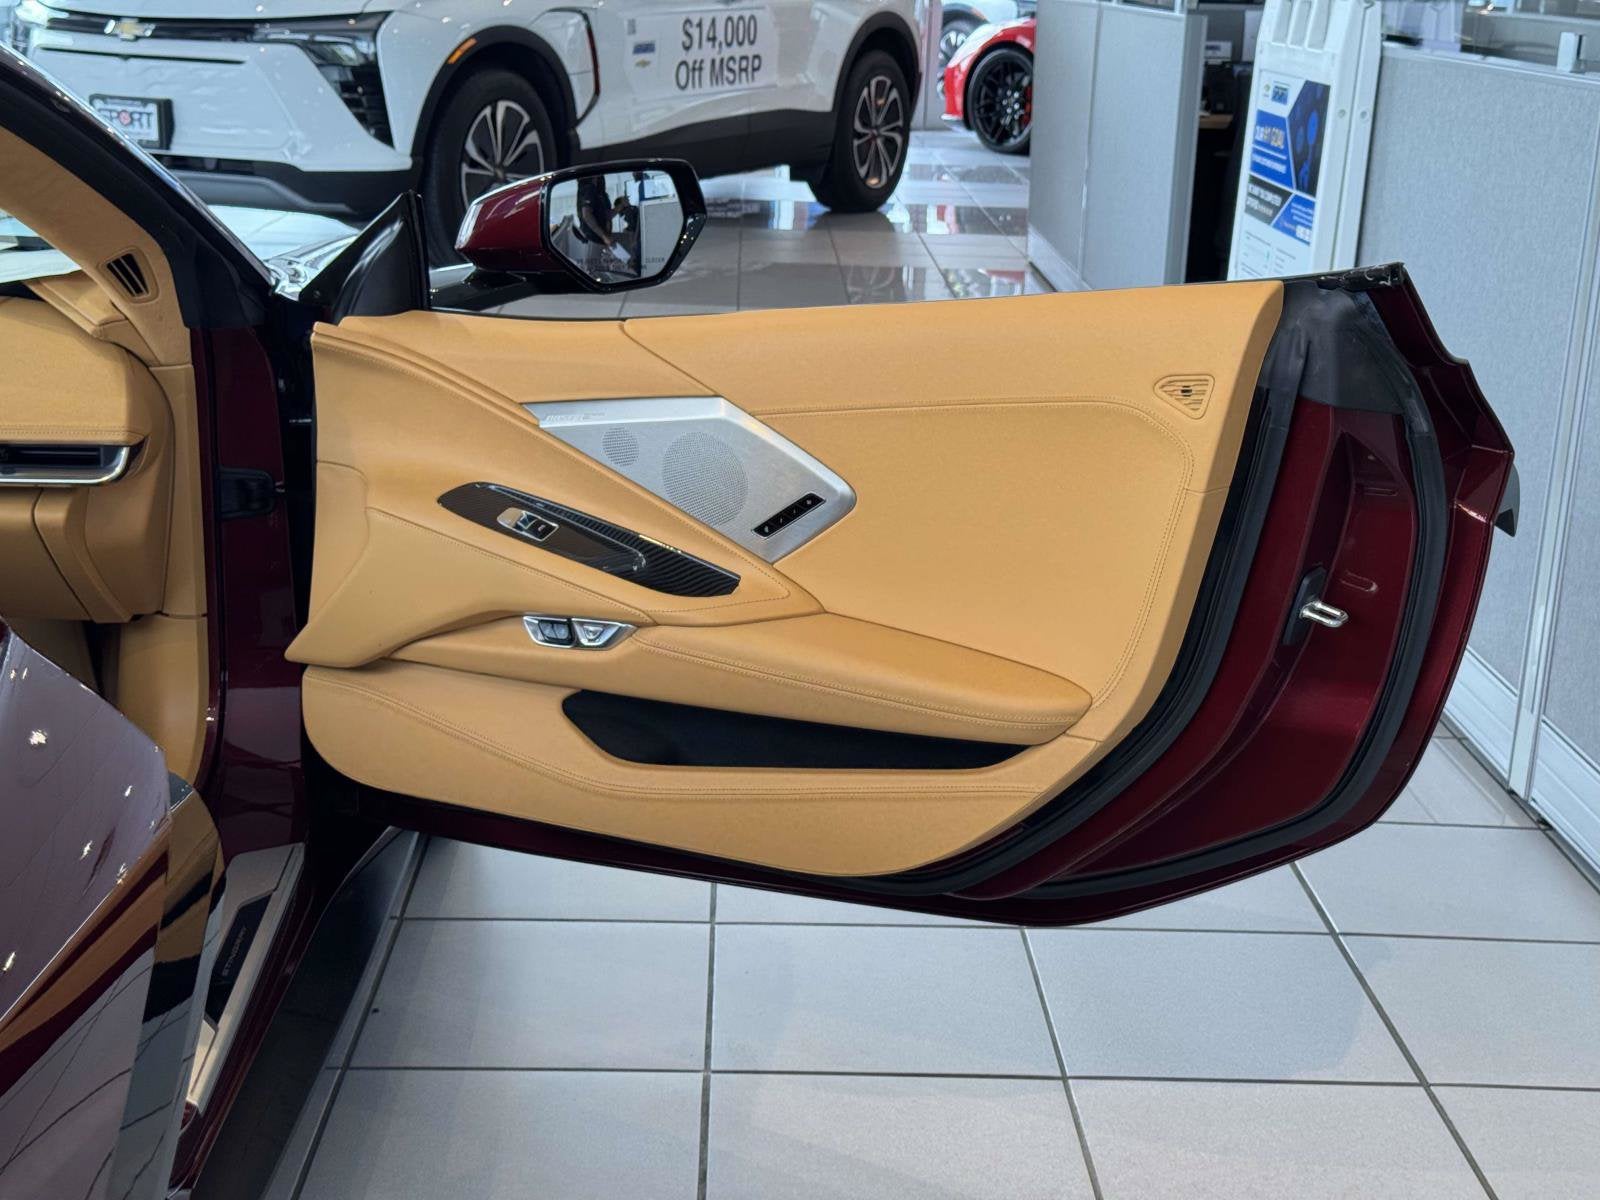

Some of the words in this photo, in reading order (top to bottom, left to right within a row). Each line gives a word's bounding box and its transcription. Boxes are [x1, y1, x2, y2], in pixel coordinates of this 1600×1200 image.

[682, 14, 757, 54] $14,000
[675, 59, 704, 90] Off
[710, 54, 762, 87] MSRP
